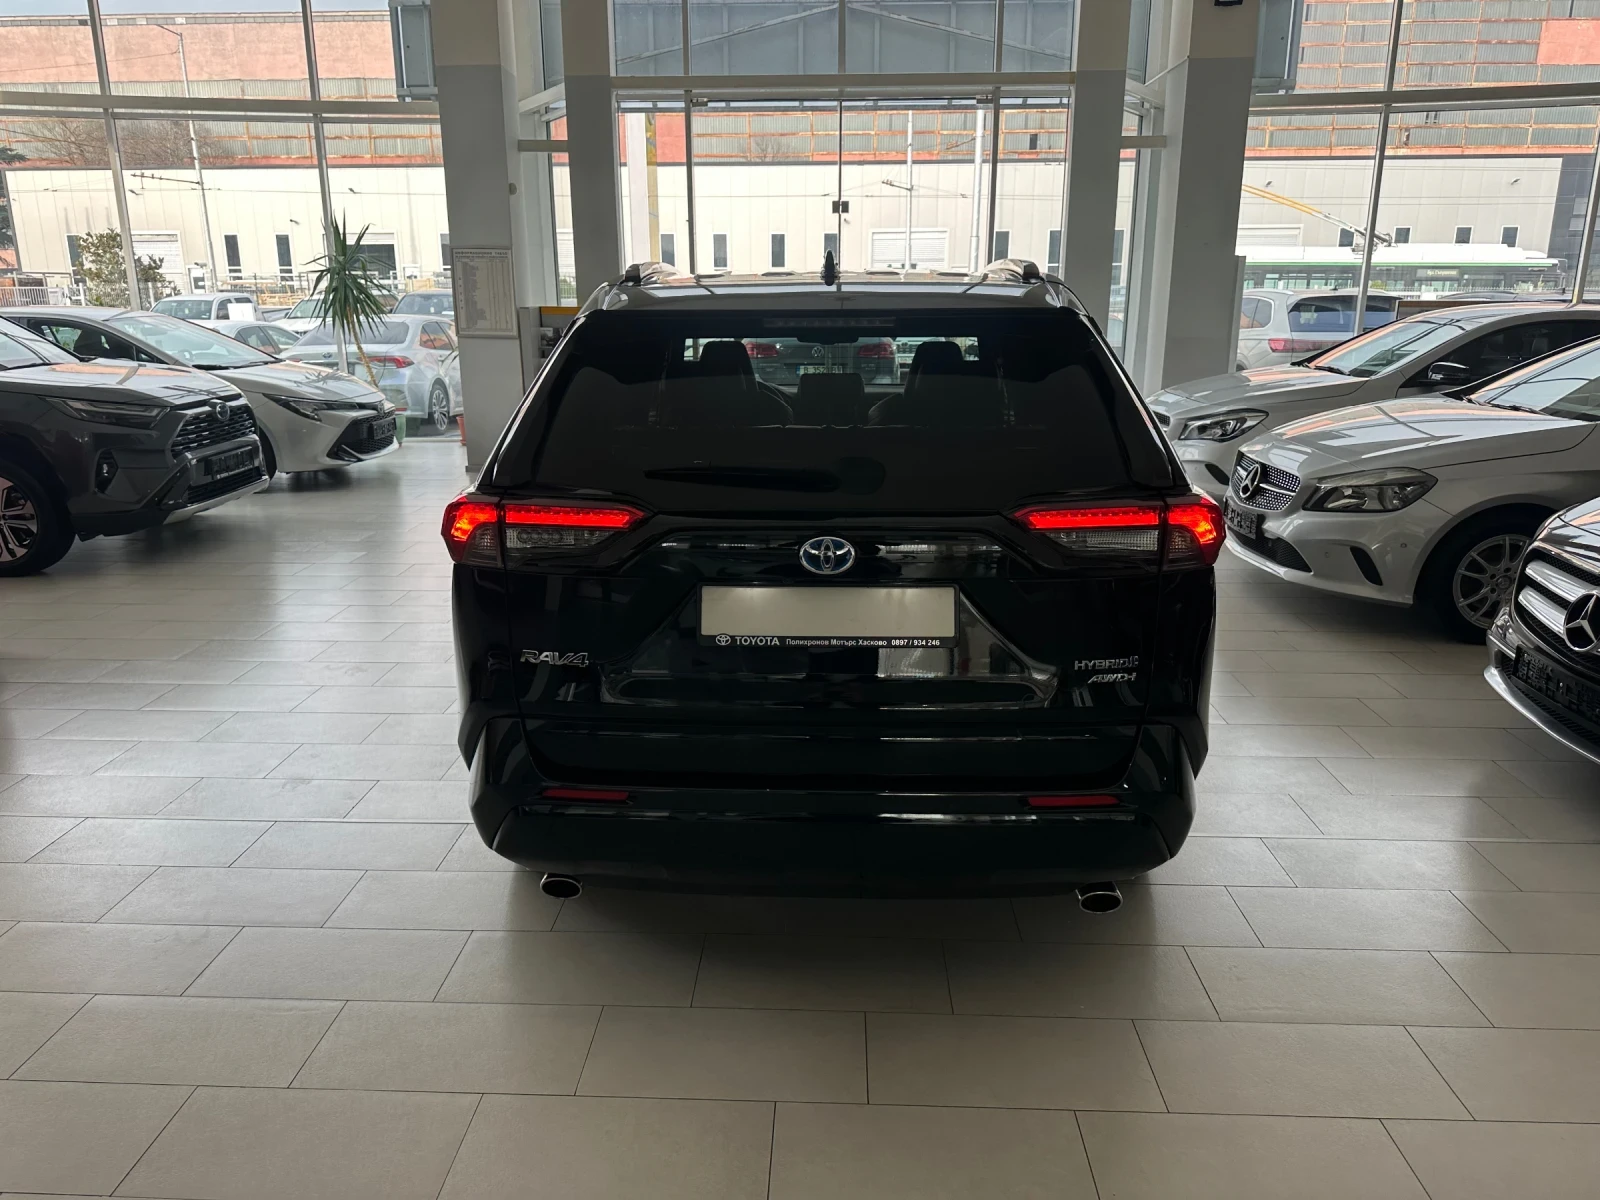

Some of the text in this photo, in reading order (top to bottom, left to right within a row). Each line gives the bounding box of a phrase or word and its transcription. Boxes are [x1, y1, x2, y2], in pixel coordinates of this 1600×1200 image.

[734, 636, 781, 646] TOYOTA
[786, 638, 830, 647] Полихронов
[830, 638, 857, 647] Мотърс
[858, 639, 888, 647] Хасково
[519, 649, 589, 668] RAV4
[1073, 658, 1129, 671] HYBRID
